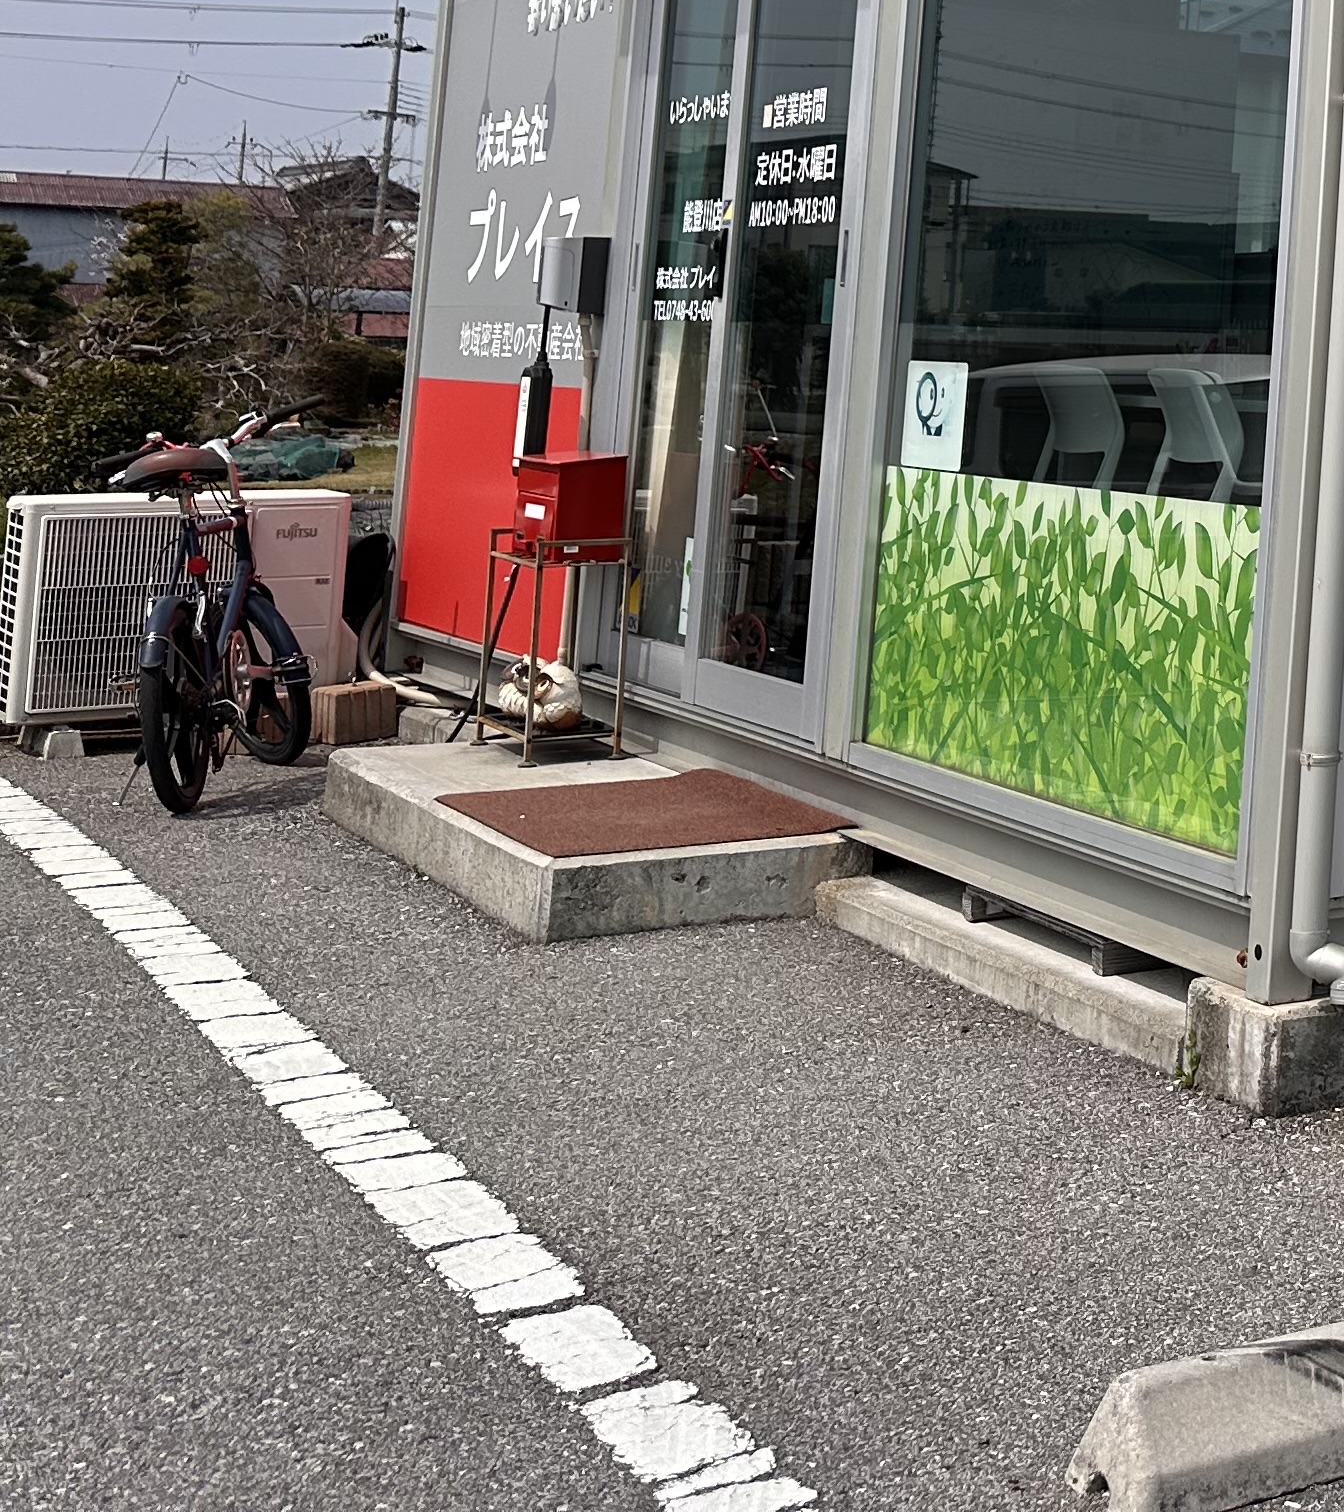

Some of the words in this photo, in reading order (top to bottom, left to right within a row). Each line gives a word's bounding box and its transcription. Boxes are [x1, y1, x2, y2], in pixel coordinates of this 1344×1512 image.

[669, 90, 732, 125] いらっしゃいま
[476, 102, 549, 172] 株式会社
[690, 265, 716, 289] プレイ
[276, 522, 318, 542] FUJITSU
